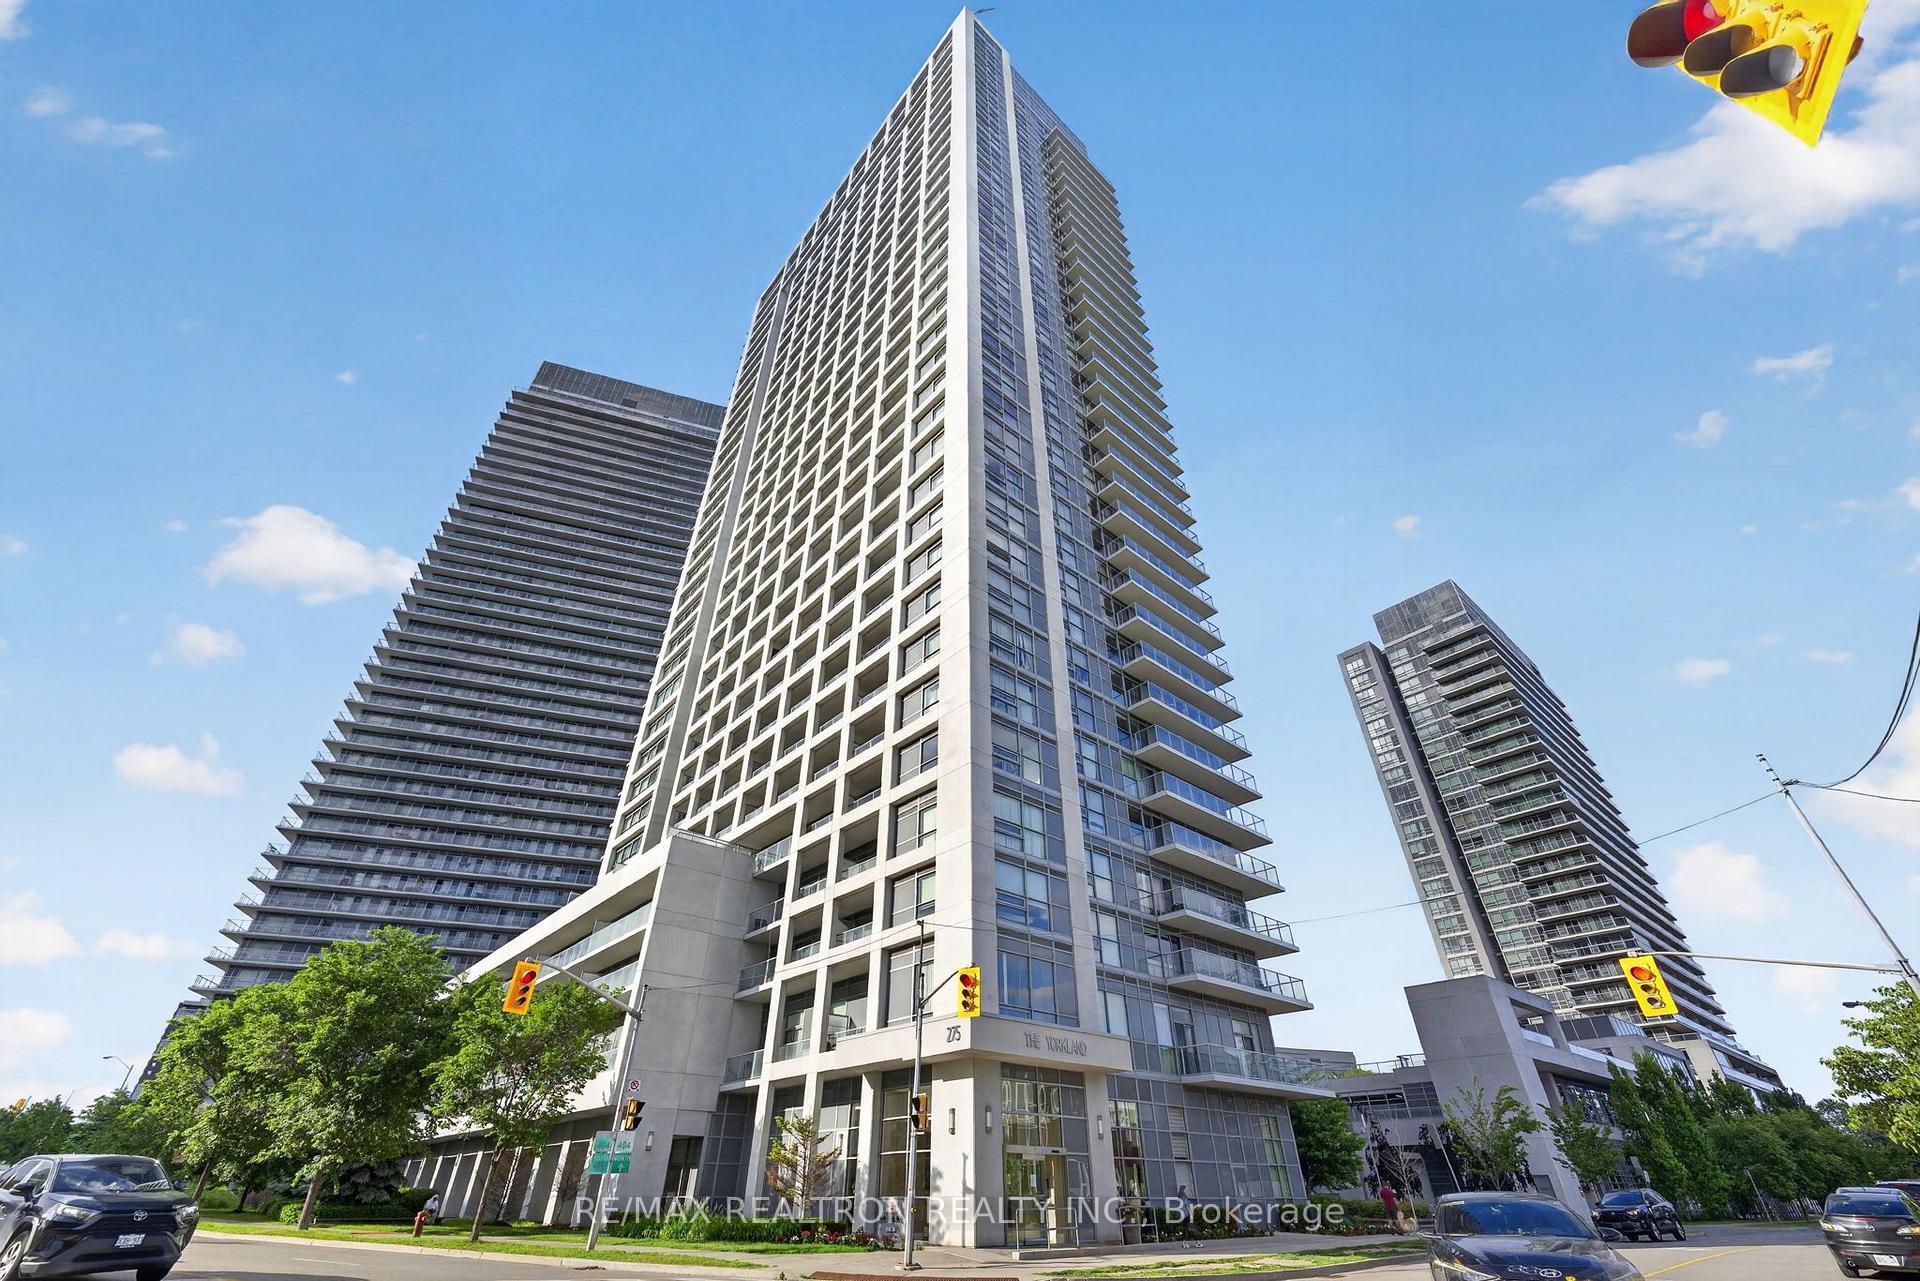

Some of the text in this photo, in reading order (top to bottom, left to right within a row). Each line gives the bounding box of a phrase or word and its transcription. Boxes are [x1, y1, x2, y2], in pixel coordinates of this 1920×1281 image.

[946, 1025, 961, 1043] 275
[1024, 1032, 1087, 1057] THE YORKLAND
